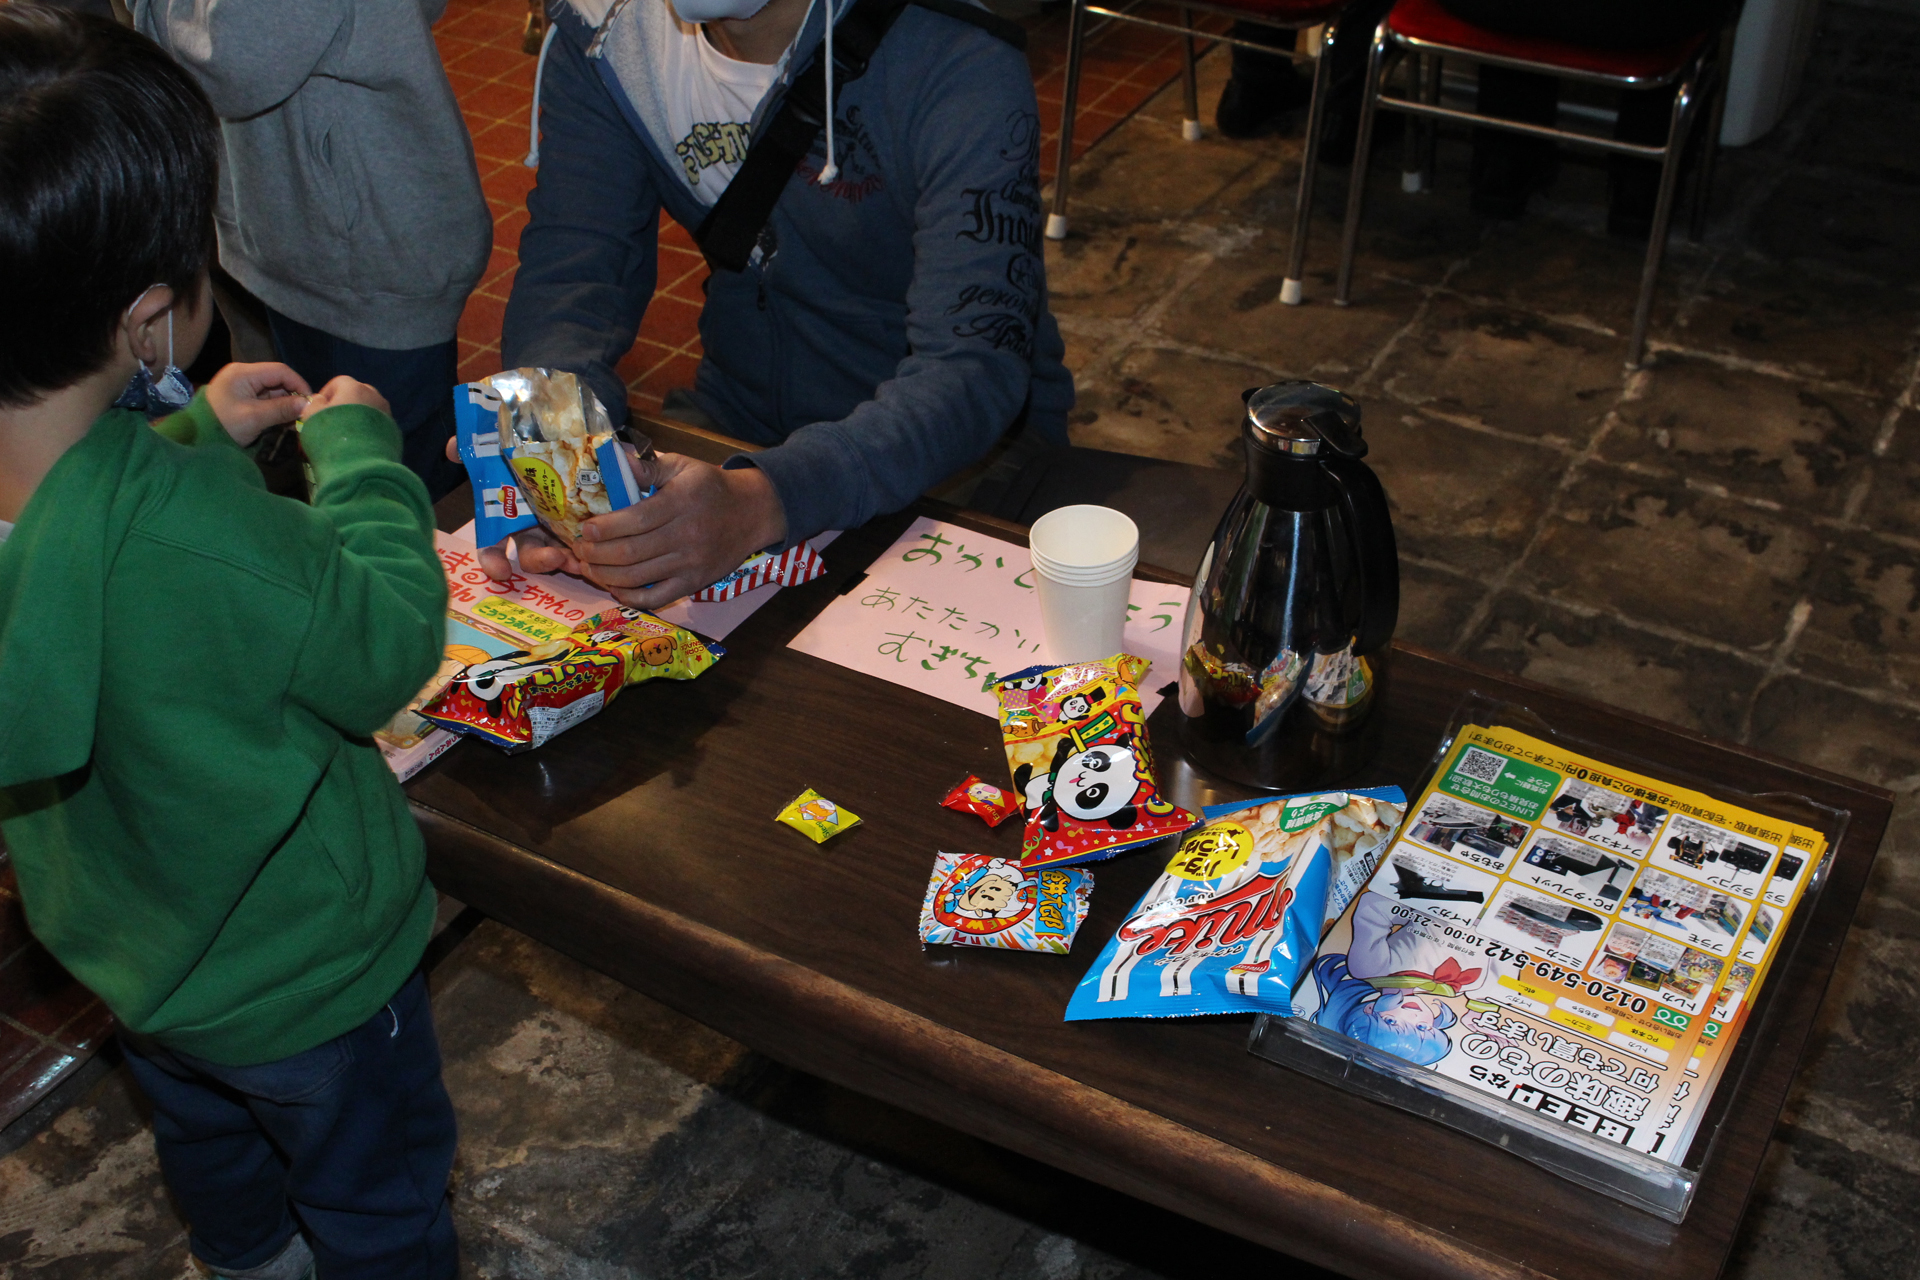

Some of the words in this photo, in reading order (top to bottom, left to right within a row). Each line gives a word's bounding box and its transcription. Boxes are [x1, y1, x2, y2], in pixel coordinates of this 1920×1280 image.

[860, 586, 1041, 655] あたたかい
[1447, 773, 1540, 809] お見積もりも大歓迎!
[1514, 778, 1548, 794] お気軽に
[1526, 775, 1552, 789] どうぞ
[1448, 782, 1535, 817] LINEでのお問合せ
[982, 803, 1000, 820] Enjoy
[1587, 832, 1643, 856] フィギュア
[1458, 848, 1505, 870] おもちゃ
[1528, 874, 1614, 911] PC・タブレット
[1706, 874, 1755, 896] ラジコン
[1388, 904, 1432, 927] 21:00
[1426, 903, 1473, 926] トイガン
[1442, 924, 1485, 947] 10:00
[1687, 932, 1724, 951] プラモ
[1532, 944, 1583, 968] ミニカー
[1481, 941, 1649, 1014] 0120-549-542
[1504, 993, 1533, 1008] トイガン
[1569, 1003, 1600, 1019] おもちゃ
[1661, 991, 1697, 1011] トレカ
[1562, 1016, 1593, 1031] ミニカー
[1629, 1026, 1646, 1038] 本体
[1626, 1040, 1649, 1053] トレカ
[1645, 1032, 1659, 1043] PC
[1472, 1011, 1660, 1094] 何でも買います
[1459, 1034, 1649, 1122] 趣味のもの
[1464, 1063, 1512, 1091] なら
